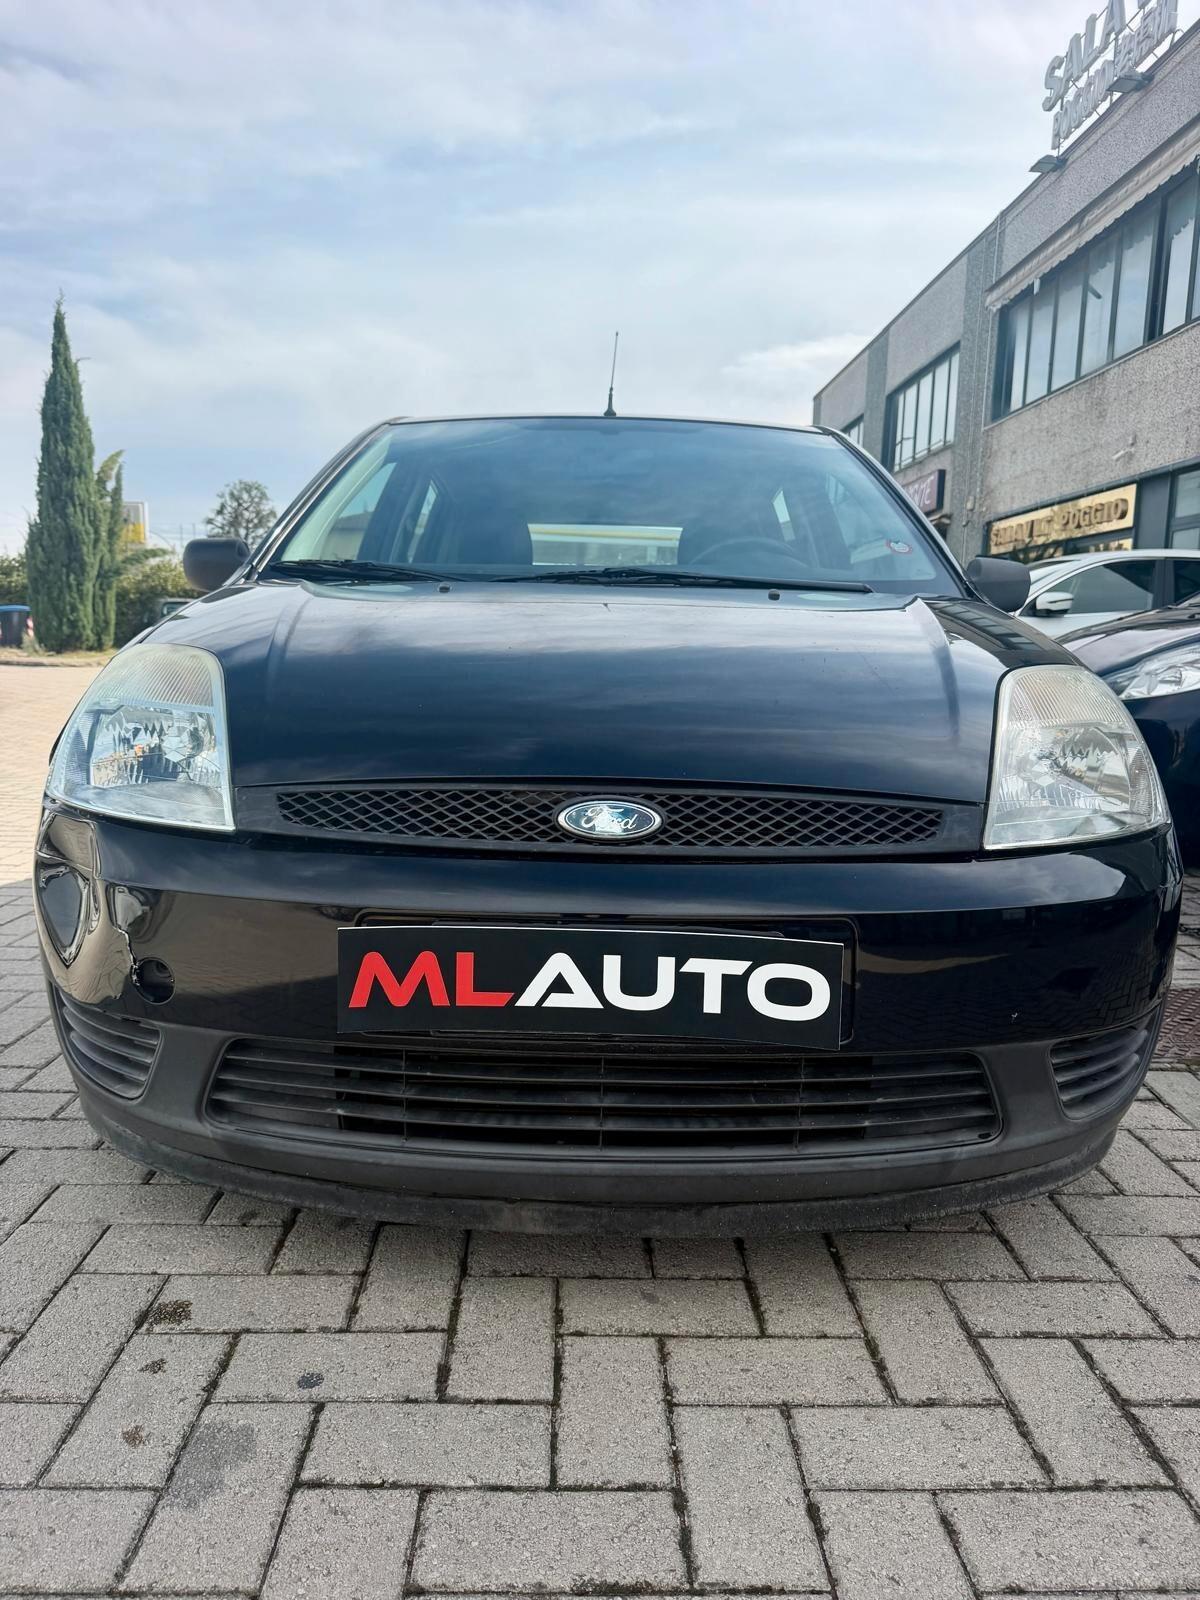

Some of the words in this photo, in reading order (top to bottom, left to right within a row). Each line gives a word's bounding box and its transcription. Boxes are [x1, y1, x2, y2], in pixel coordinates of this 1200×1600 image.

[1042, 0, 1126, 111] SALA
[1060, 498, 1129, 531] POGGIO
[581, 804, 638, 829] Frd
